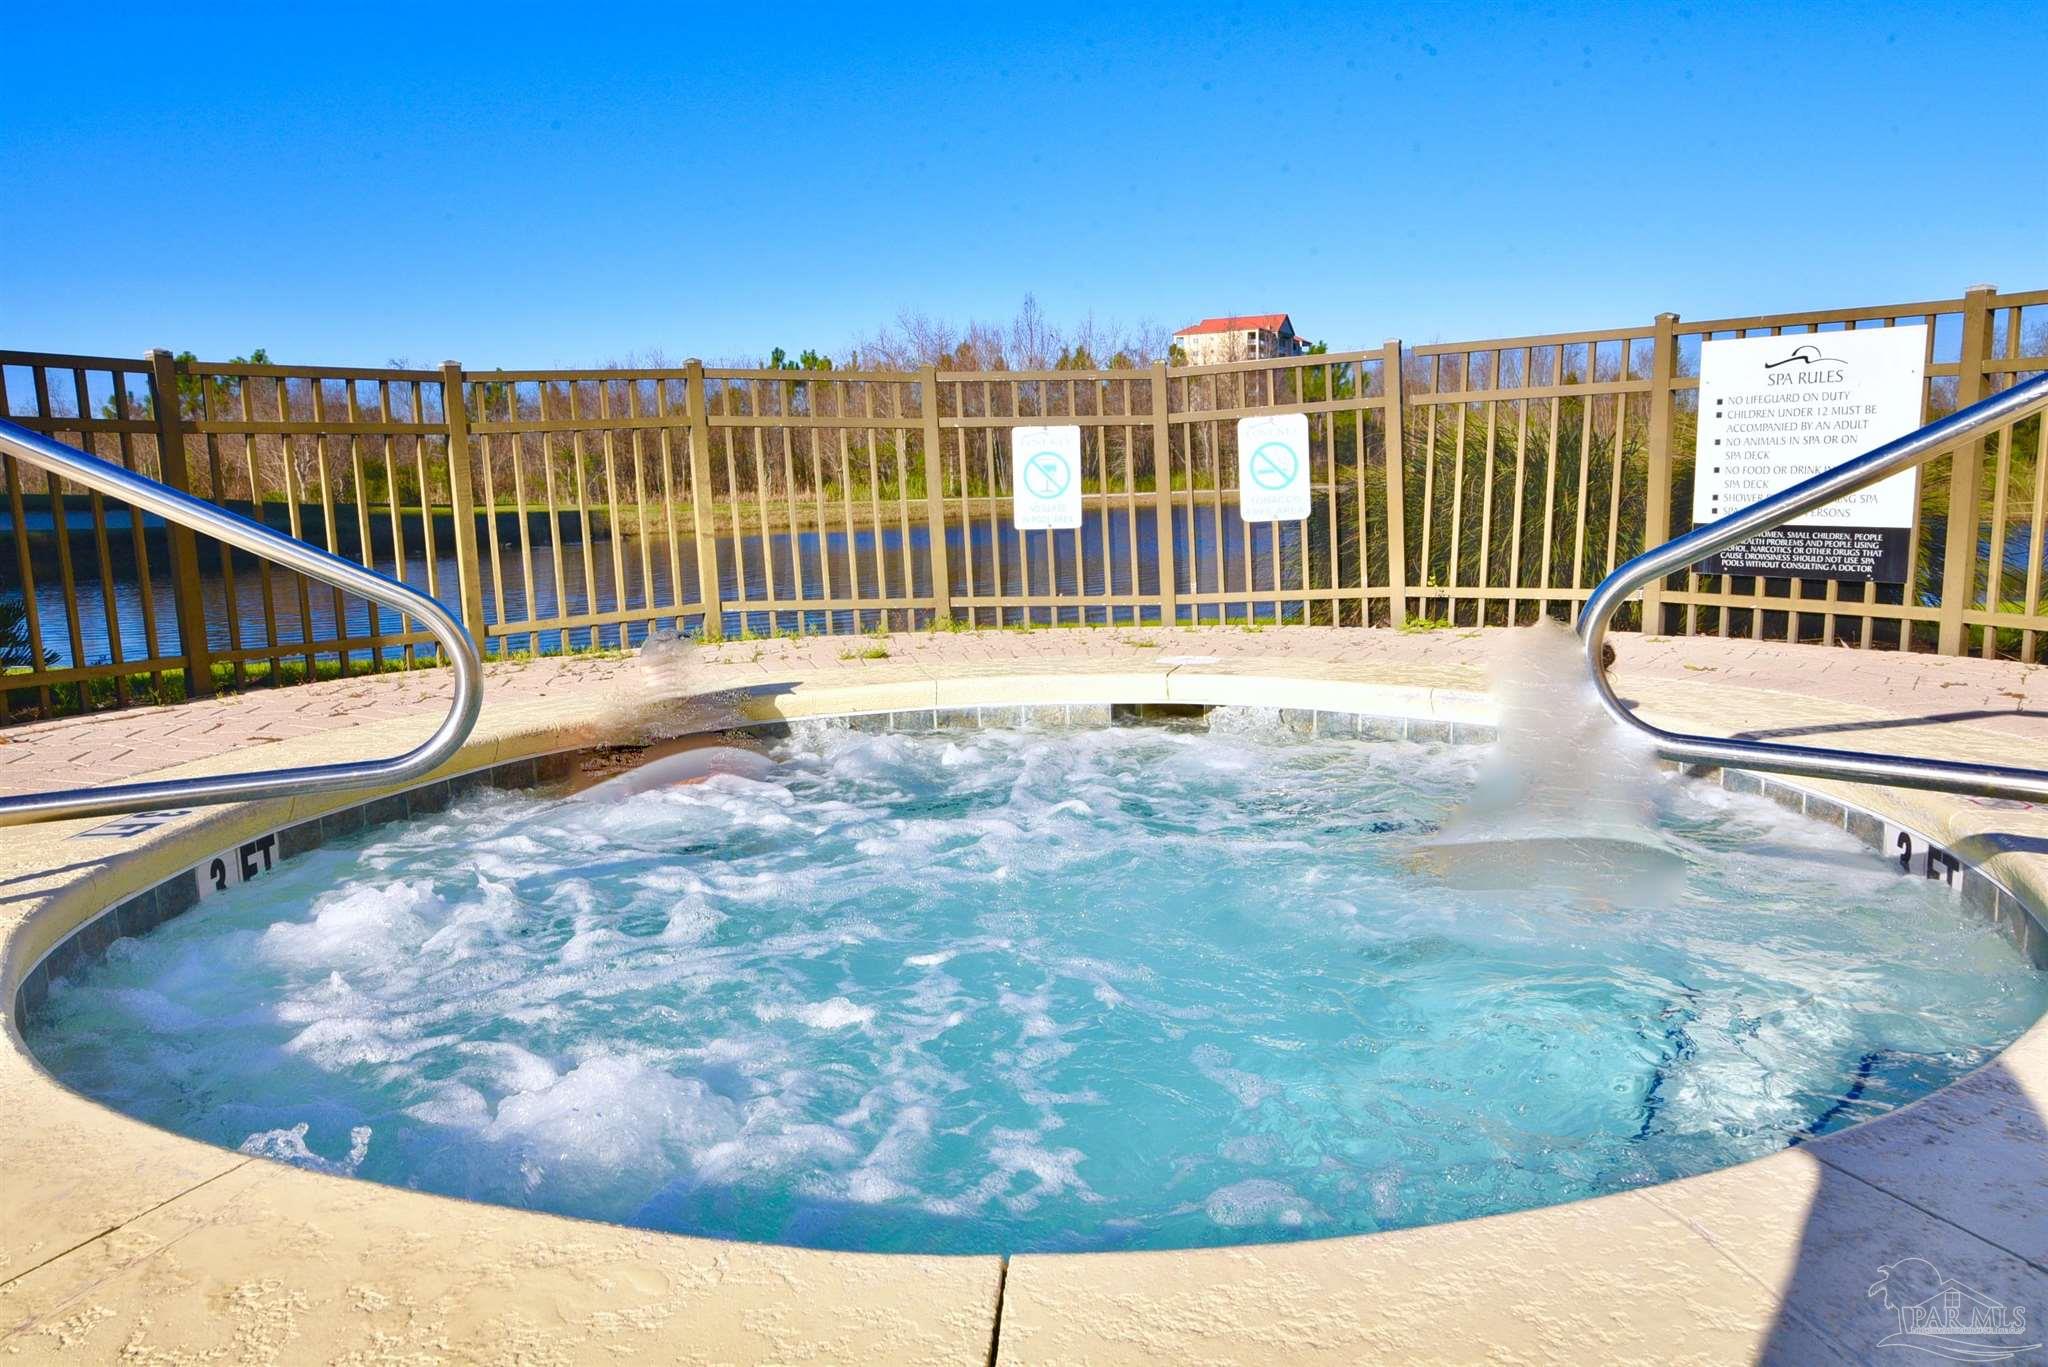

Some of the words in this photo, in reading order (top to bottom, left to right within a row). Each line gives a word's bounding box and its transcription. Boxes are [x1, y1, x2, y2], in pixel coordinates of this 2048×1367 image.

[1767, 373, 1793, 386] SPA
[1798, 369, 1844, 384] RULES
[1728, 396, 1743, 405] NO
[1746, 393, 1800, 404] LIFEGUARD
[1803, 393, 1818, 402] ON
[1822, 391, 1849, 401] DUTY
[1727, 410, 1775, 419] CHILDREN
[1778, 407, 1813, 417] UNDER
[1817, 407, 1828, 416] 12
[1831, 405, 1861, 415] MUST
[1865, 404, 1877, 414] BE
[1726, 422, 1798, 433] ACCOMPANIED
[1801, 421, 1813, 430] BY
[1815, 420, 1831, 430] AN
[1833, 419, 1869, 430] ADULT
[1726, 437, 1741, 446] NO
[1743, 436, 1786, 446] ANIMALS
[1789, 436, 1800, 445] IN
[1803, 435, 1820, 445] SPA
[1823, 434, 1839, 444] OR
[1841, 434, 1858, 444] ON
[1725, 450, 1741, 460] SPA
[1744, 450, 1770, 460] DECK
[1725, 466, 1740, 475] NO
[1742, 465, 1770, 475] FOOD
[1773, 465, 1788, 475] OR
[1790, 465, 1821, 474] DRINK
[1724, 479, 1740, 489] SPA
[1743, 479, 1769, 489] DECK
[1860, 494, 1878, 504] SPA
[1806, 507, 1851, 517] ERSONS
[1787, 531, 1810, 539] SMALL
[1743, 538, 1765, 546] EALTH
[1766, 539, 1804, 547] PROBLEMS
[1750, 545, 1792, 554] NARCOTICS
[1805, 547, 1831, 555] OTHER
[1833, 548, 1860, 556] DRUGS
[1720, 552, 1743, 560] CAUSE
[1744, 552, 1791, 561] DROWSINESS
[1843, 556, 1859, 564] USE
[1860, 557, 1875, 565] SPA
[1721, 559, 1744, 567] POOLS
[1745, 560, 1779, 568] WITHOUT
[1781, 561, 1829, 571] CONSULTING
[1838, 564, 1873, 573] DOCTOR
[239, 833, 276, 882] FT
